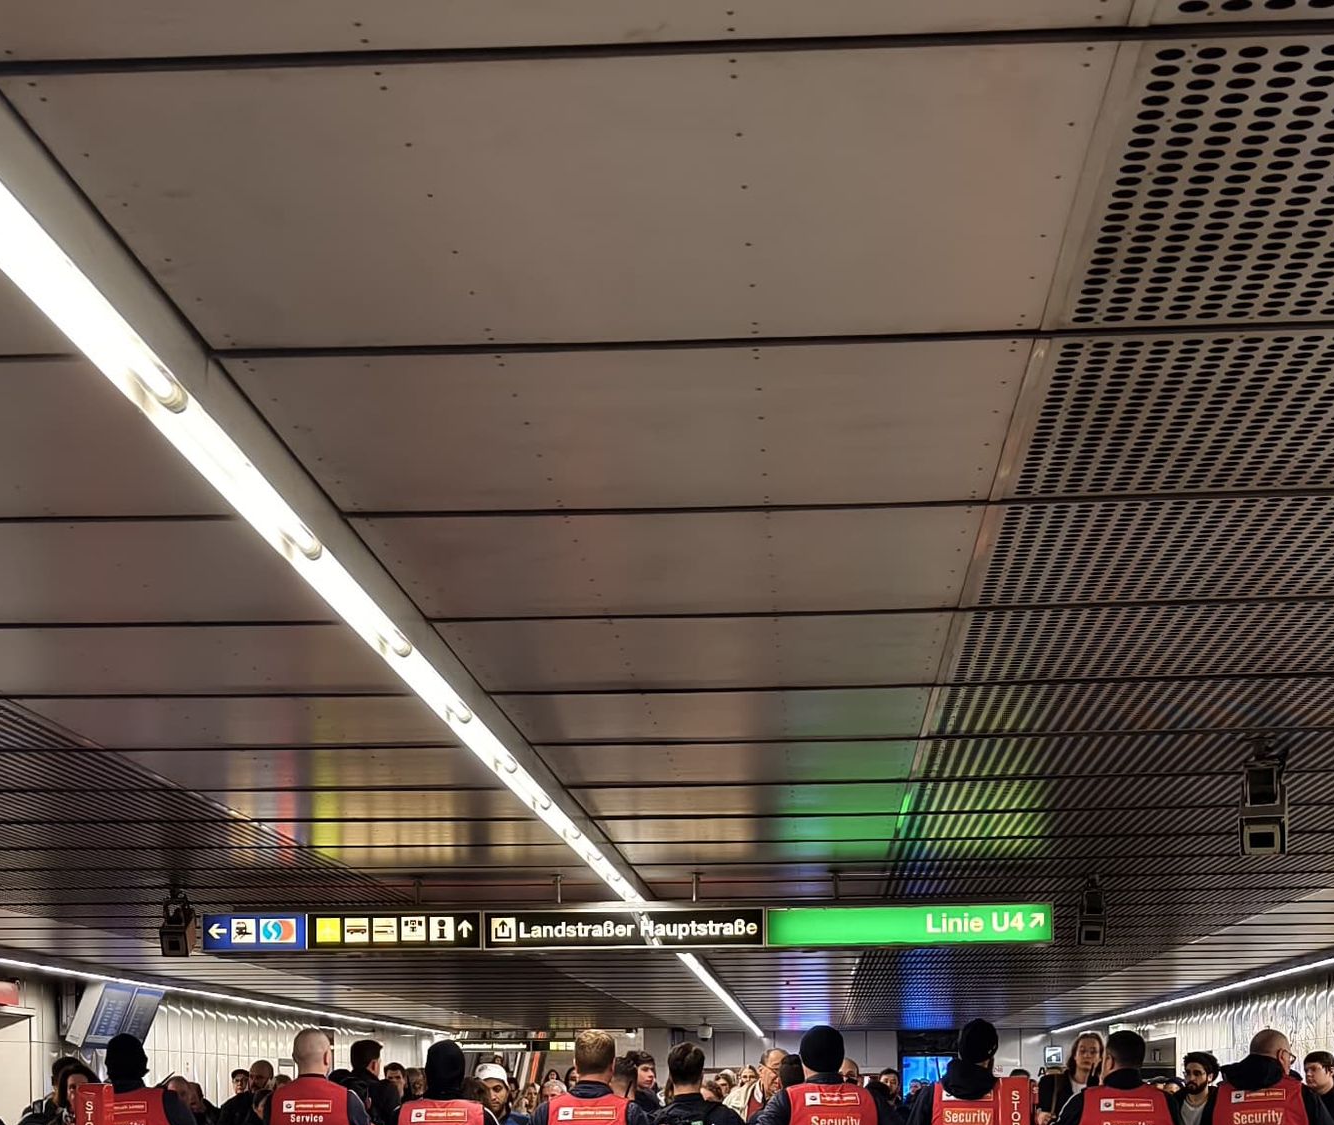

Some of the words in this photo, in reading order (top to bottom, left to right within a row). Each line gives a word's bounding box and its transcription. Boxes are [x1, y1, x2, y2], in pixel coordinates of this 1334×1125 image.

[518, 920, 636, 939] Landstraßer
[640, 919, 758, 940] Hauptstraße
[926, 912, 985, 933] Linie
[991, 911, 1026, 932] U4
[290, 1113, 324, 1123] Service
[944, 1109, 993, 1125] Security
[1232, 1108, 1284, 1125] Security
